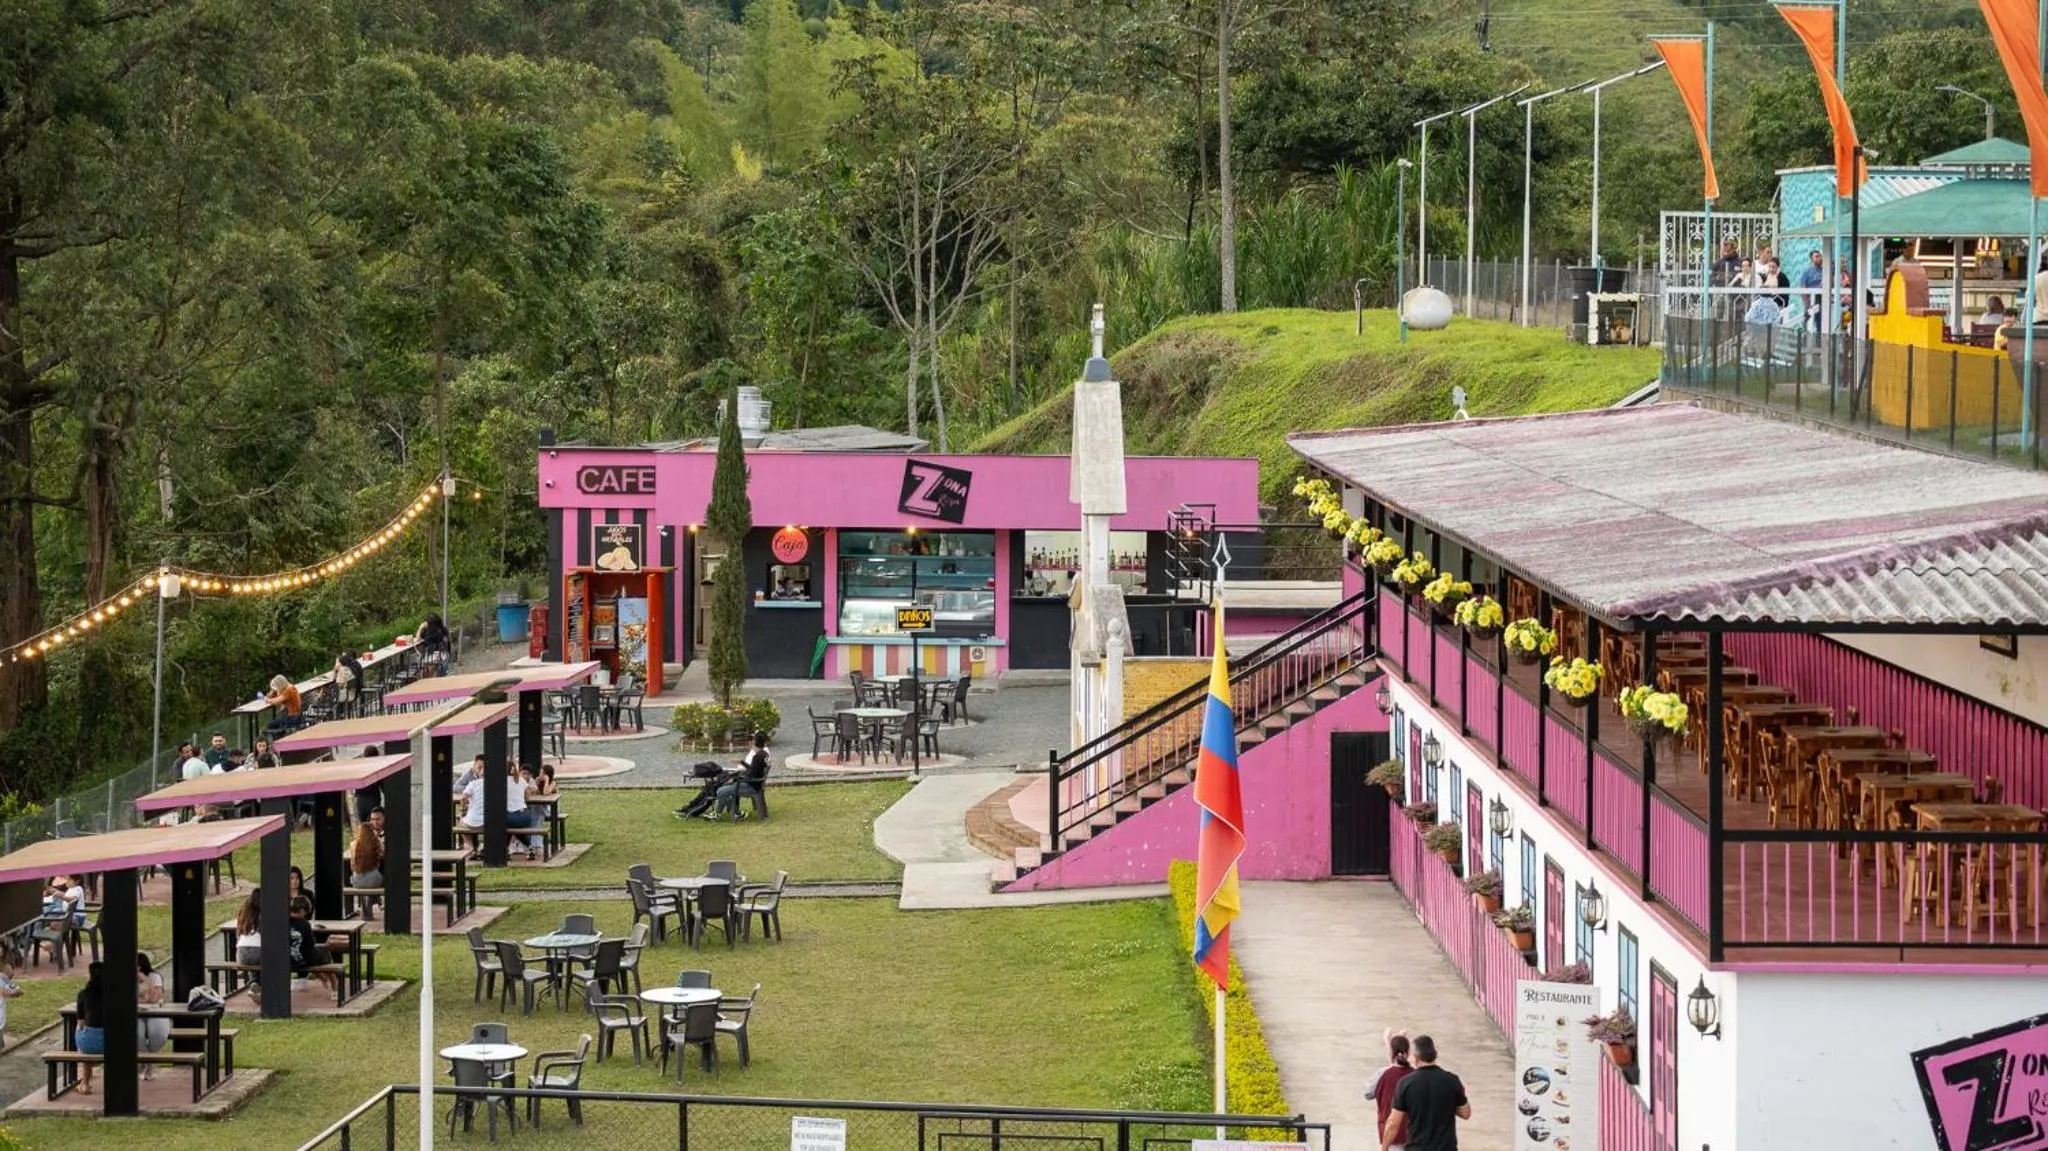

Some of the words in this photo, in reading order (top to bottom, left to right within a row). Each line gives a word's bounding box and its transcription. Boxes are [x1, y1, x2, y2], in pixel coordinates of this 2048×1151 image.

[578, 467, 656, 493] CAFE
[775, 535, 804, 557] Caja
[1524, 988, 1593, 1005] RESTAURANTE
